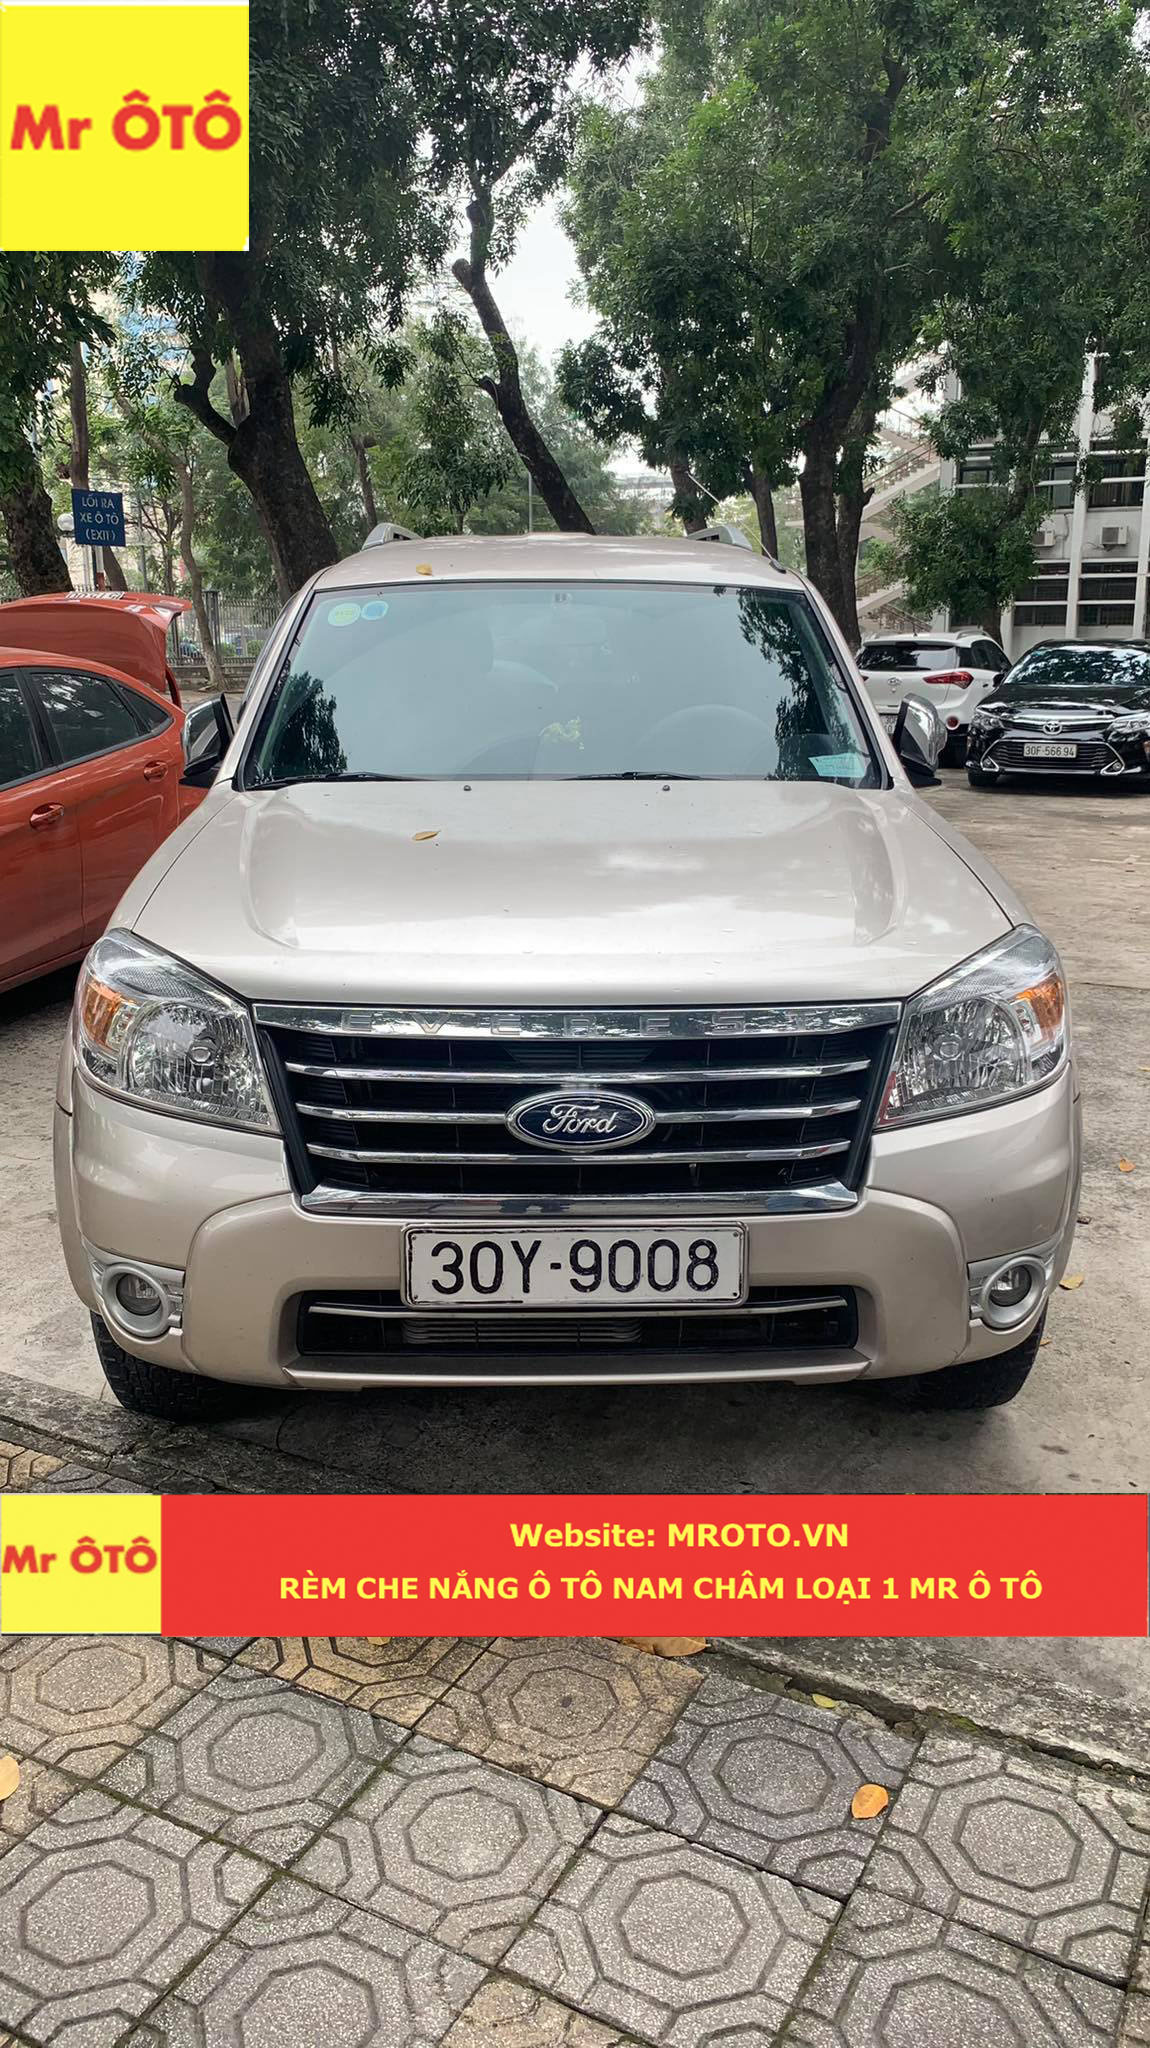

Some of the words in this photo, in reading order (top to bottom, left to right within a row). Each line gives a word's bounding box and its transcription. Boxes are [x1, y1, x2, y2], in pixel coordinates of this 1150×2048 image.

[101, 498, 115, 509] RA
[79, 512, 93, 523] XE
[95, 511, 104, 524] Ô
[106, 511, 119, 525] TÔ
[542, 1103, 619, 1134] Ford
[431, 1238, 720, 1295] 30Y-9008
